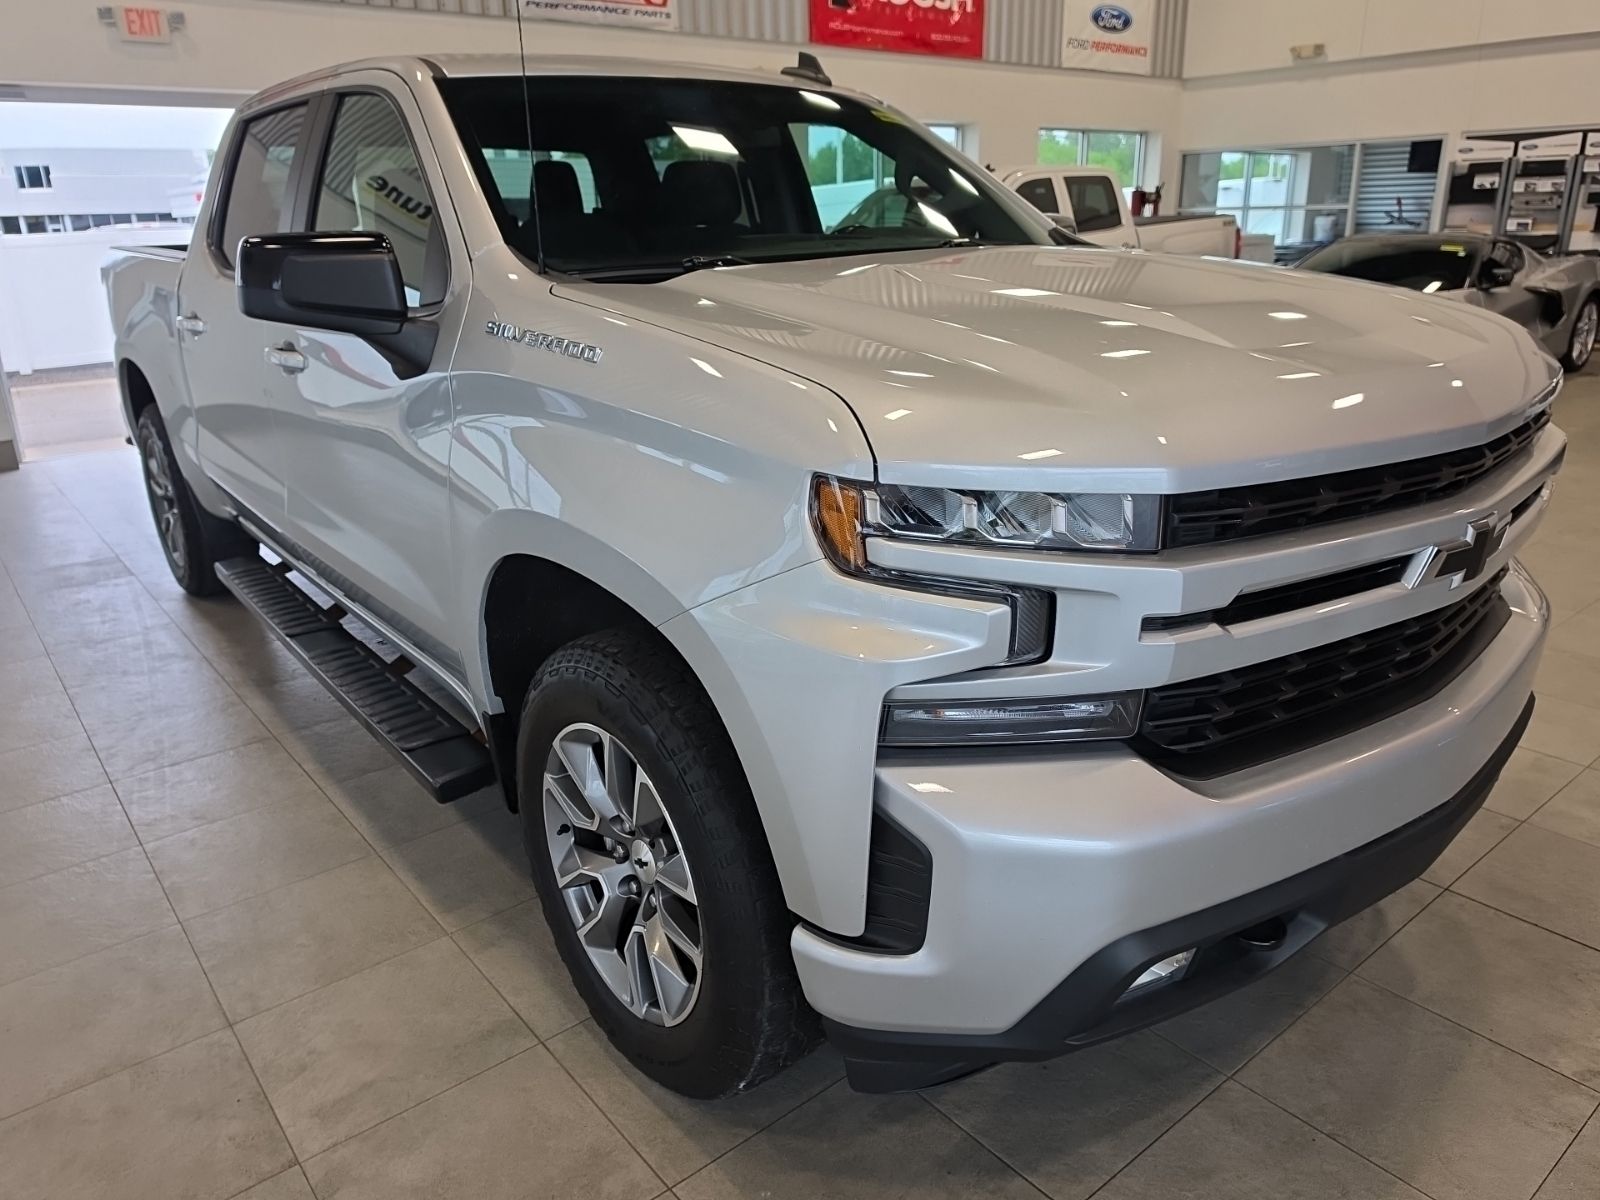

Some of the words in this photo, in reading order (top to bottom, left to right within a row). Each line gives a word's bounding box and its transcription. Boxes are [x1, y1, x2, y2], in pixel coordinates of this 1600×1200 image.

[526, 1, 631, 16] PERFORMANCE
[634, 10, 672, 19] PARTS
[1097, 8, 1126, 30] Ford
[124, 8, 161, 36] EXIT
[1066, 37, 1090, 50] FORD
[1090, 40, 1148, 58] PERFORMANCE
[485, 320, 603, 364] SILVERADO
